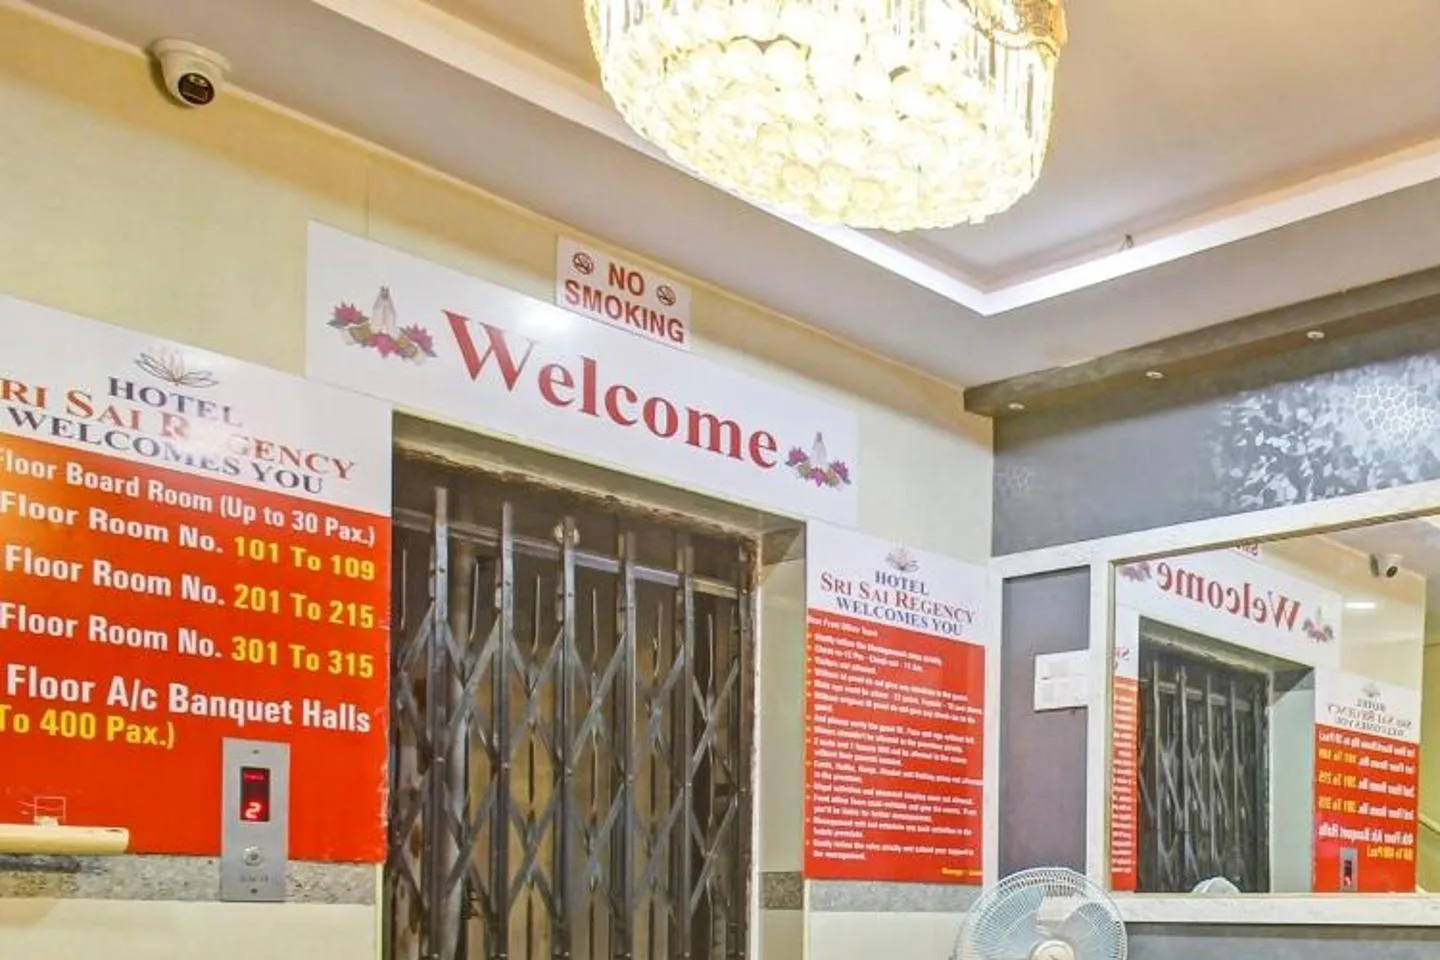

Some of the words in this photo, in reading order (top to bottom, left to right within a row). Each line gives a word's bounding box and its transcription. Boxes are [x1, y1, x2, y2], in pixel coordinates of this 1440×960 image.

[564, 279, 685, 344] SMOKING
[607, 262, 645, 297] NO
[108, 375, 243, 427] HOTEL
[441, 309, 778, 469] Welcome
[7, 406, 240, 476] WELCOMES
[251, 462, 323, 494] YOU
[66, 389, 142, 431] SAI
[158, 411, 355, 480] RGENCY
[0, 490, 79, 525] Floor
[89, 506, 169, 543] Room
[179, 524, 223, 553] No.
[233, 536, 279, 564] 101
[291, 547, 321, 570] To
[331, 554, 375, 581] 109
[66, 461, 140, 497] Board
[148, 479, 213, 512] Room
[220, 495, 257, 525] (Up
[264, 506, 286, 527] to
[291, 510, 319, 534] 30
[325, 517, 375, 548] Pax.)
[5, 544, 84, 583] Floor
[92, 558, 171, 597] Room
[181, 573, 225, 606] No.
[233, 583, 280, 614] 201
[291, 592, 321, 621] To
[329, 599, 374, 629] 215
[820, 571, 852, 597] SRI
[859, 580, 890, 605] SAI
[895, 588, 975, 624] REGENCY
[836, 596, 929, 629] WELCOMES
[932, 616, 963, 637] YOU
[875, 571, 929, 595] HOTEL
[0, 602, 78, 638] Floor
[88, 614, 168, 653] Room
[178, 627, 222, 659] No.
[231, 635, 278, 665] 301
[290, 644, 320, 672] To
[328, 650, 374, 678] 315
[7, 663, 95, 703] Floor
[107, 675, 157, 712] A/c
[168, 682, 292, 727] Banquet
[302, 699, 370, 733] Halls
[40, 708, 96, 739] 400
[107, 715, 175, 749] Pax.)
[245, 802, 261, 819] 2
